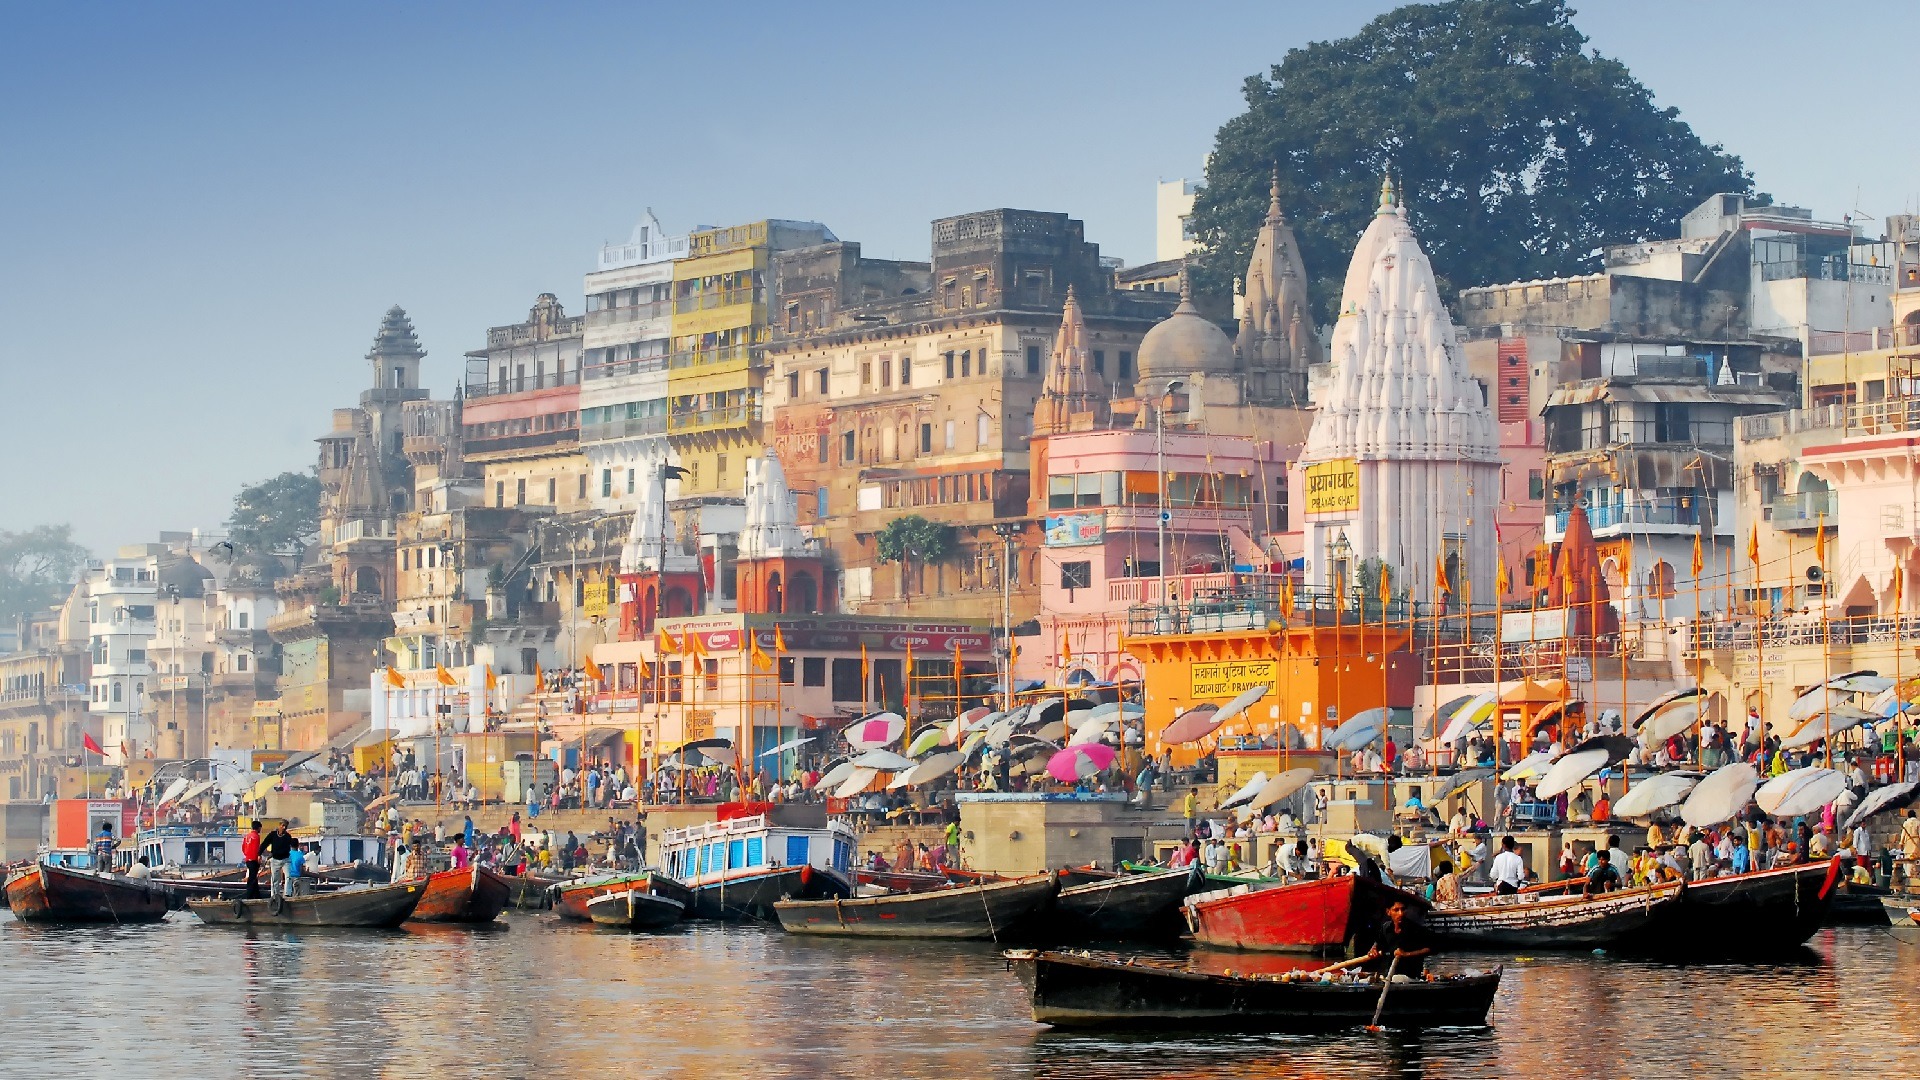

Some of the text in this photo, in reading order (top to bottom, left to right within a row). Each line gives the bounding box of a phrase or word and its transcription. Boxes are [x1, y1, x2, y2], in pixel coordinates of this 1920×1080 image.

[1338, 495, 1354, 505] GHAT
[1194, 683, 1226, 695] प्रयाग घाट
[1232, 682, 1258, 691] PRAYAG
